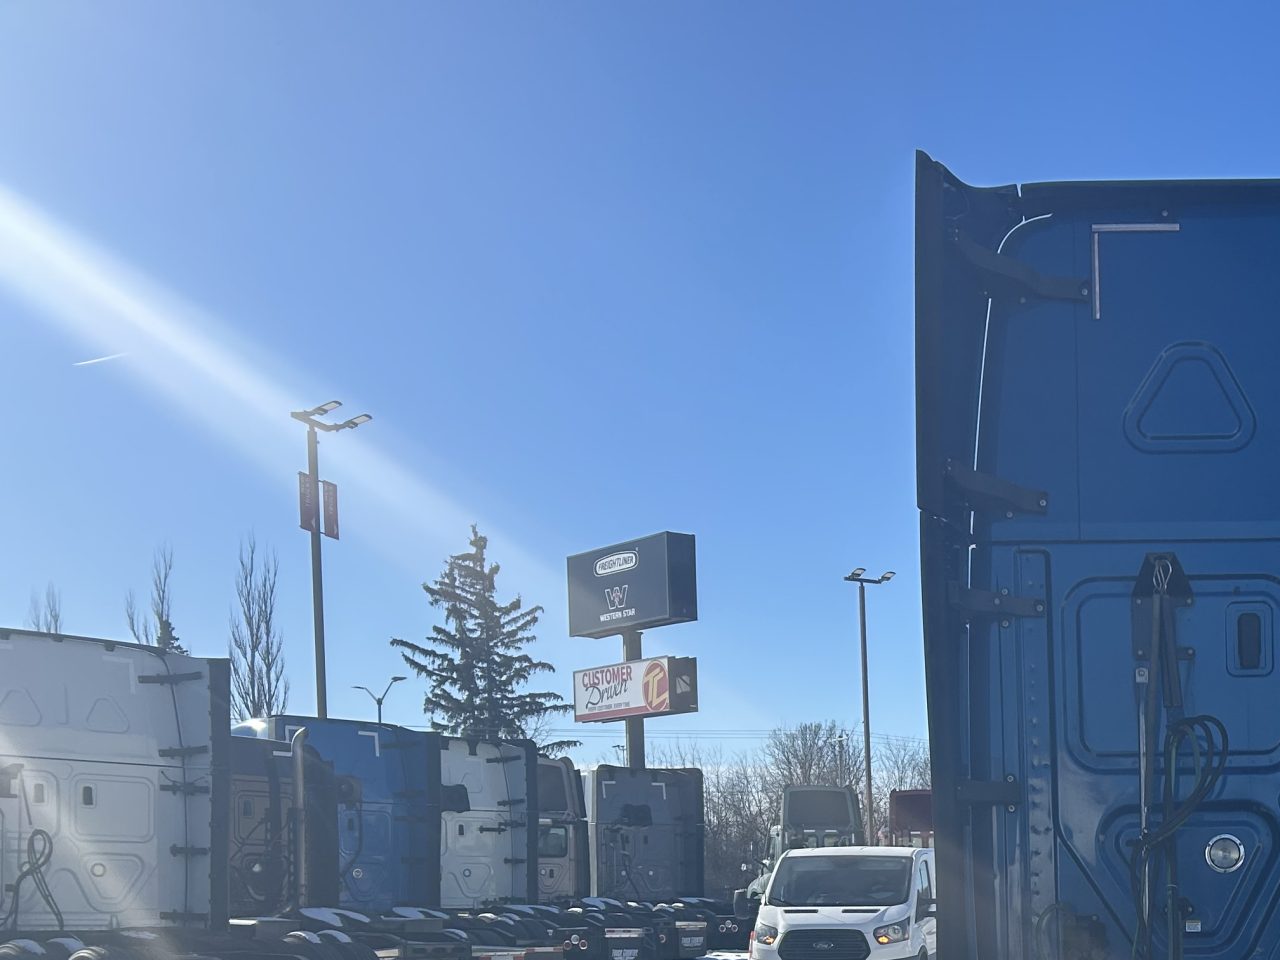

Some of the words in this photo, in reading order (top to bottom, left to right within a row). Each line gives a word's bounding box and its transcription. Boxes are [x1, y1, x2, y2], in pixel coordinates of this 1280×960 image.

[598, 556, 634, 572] FREIGHTLINER
[600, 611, 622, 622] WESTERN
[623, 608, 636, 618] STAR
[582, 665, 633, 688] CUSTOMER
[585, 679, 629, 709] Driven
